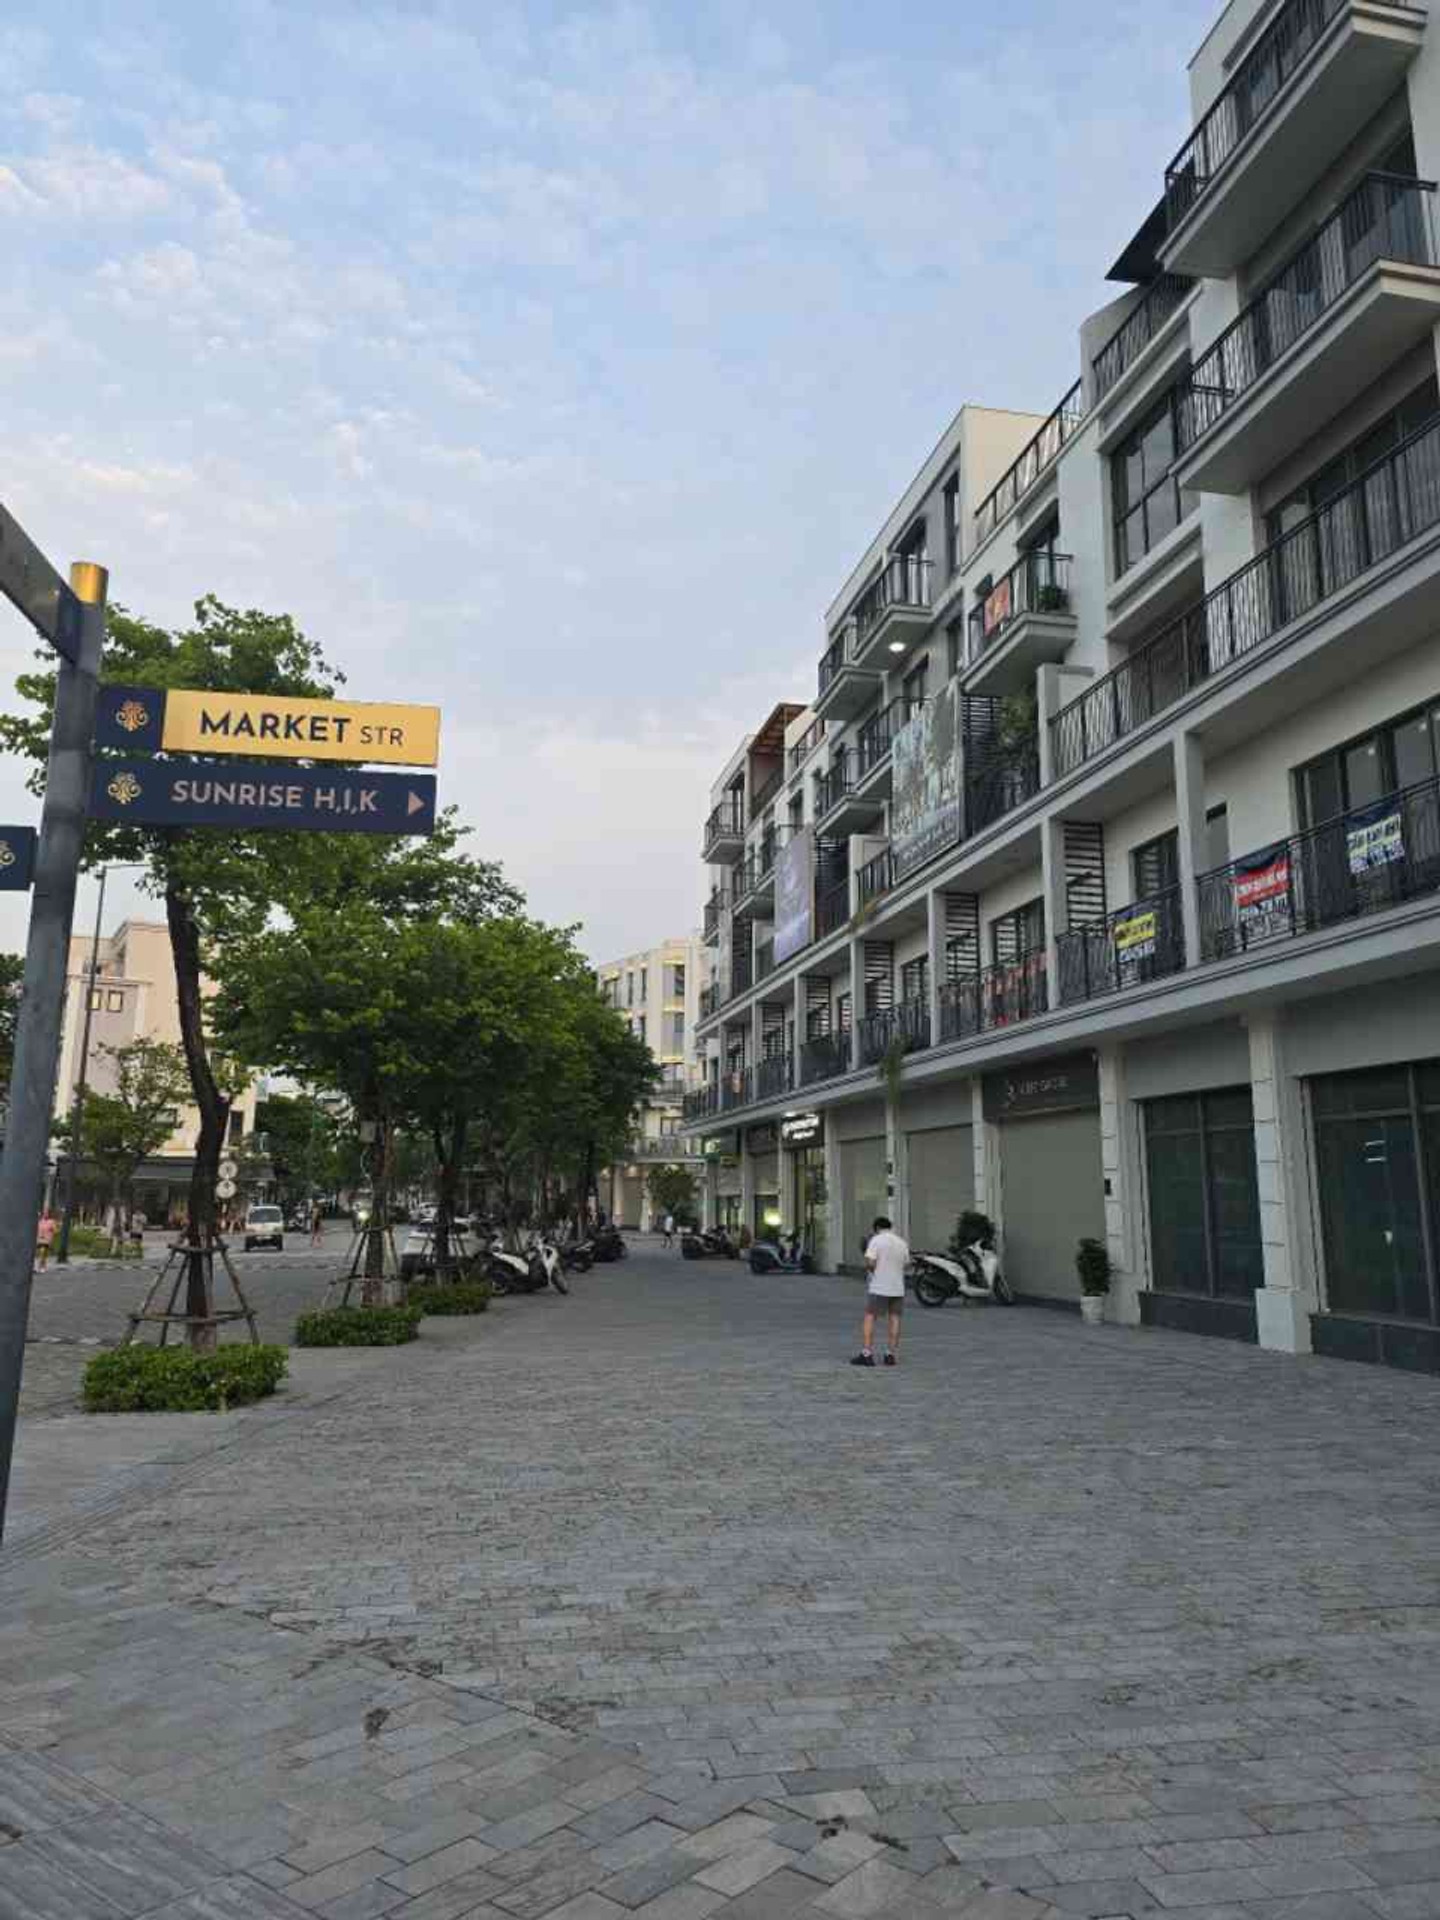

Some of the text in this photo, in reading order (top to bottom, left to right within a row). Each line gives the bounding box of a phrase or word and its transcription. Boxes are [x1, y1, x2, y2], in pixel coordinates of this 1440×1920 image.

[200, 709, 404, 746] MARKET STR
[171, 779, 378, 816] SUNRISE H,I,K
